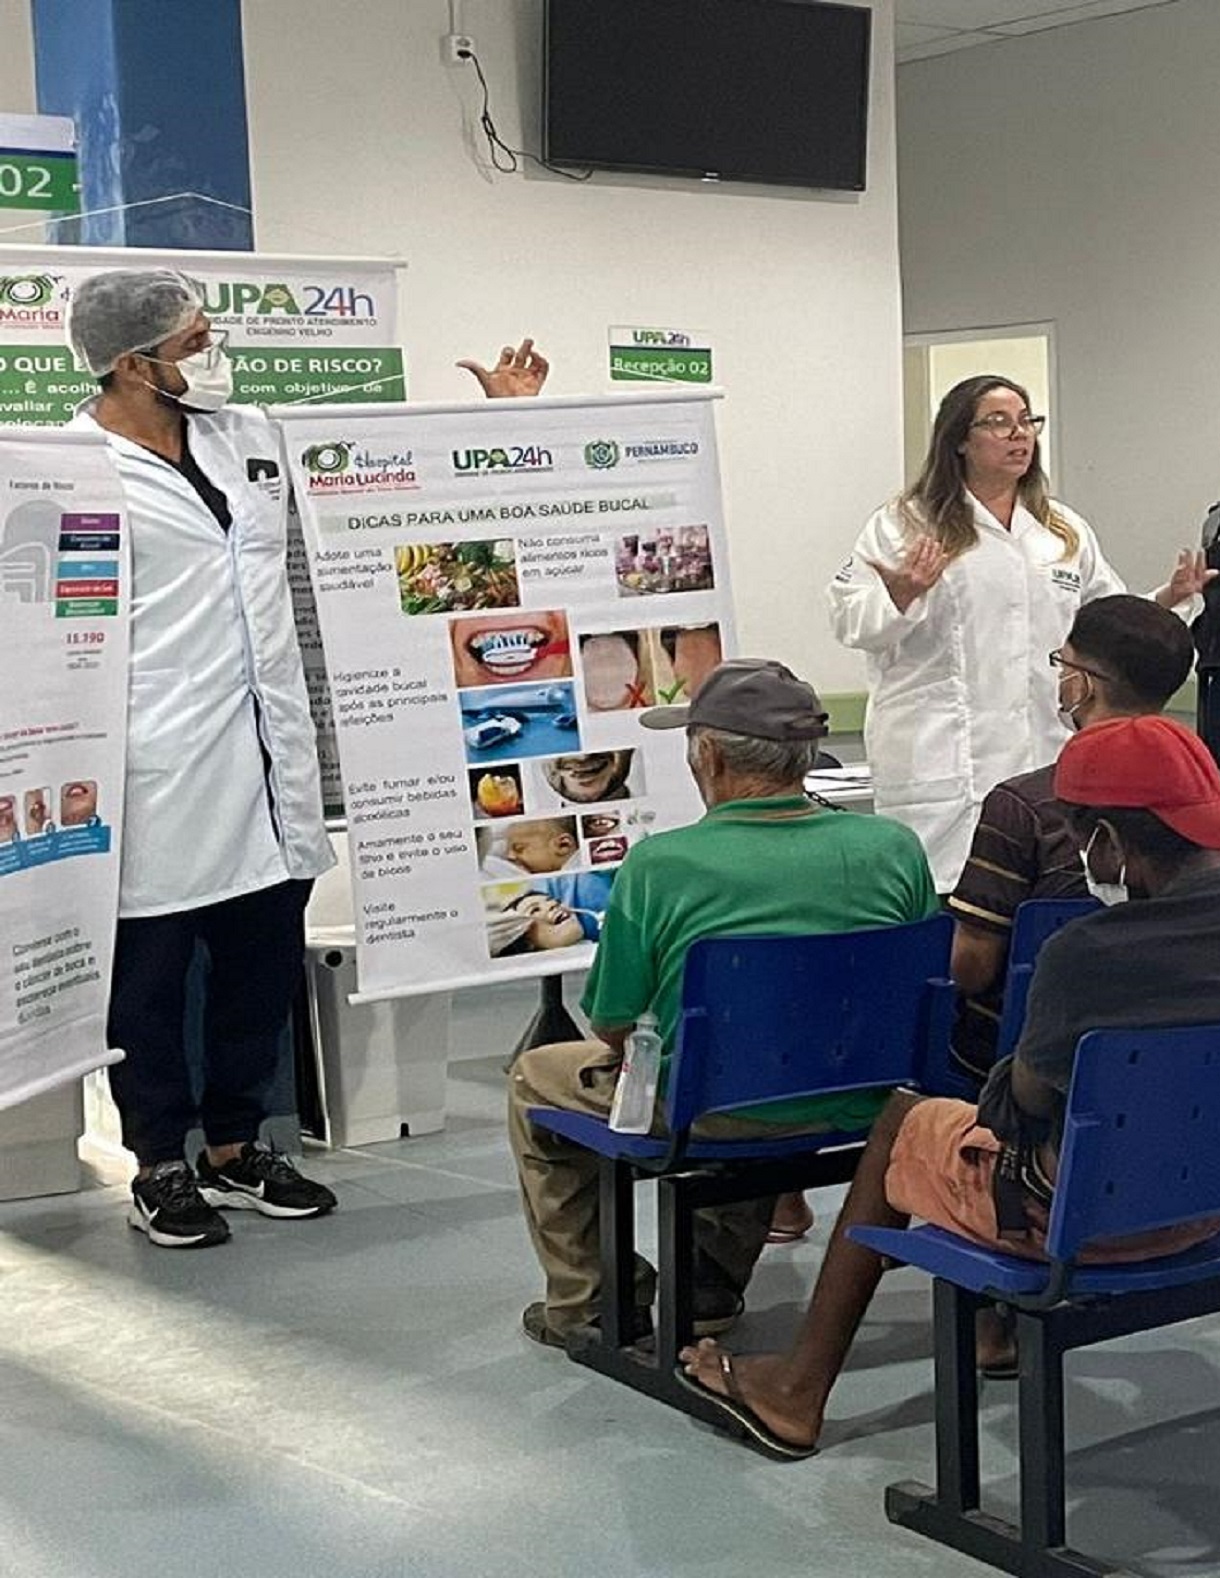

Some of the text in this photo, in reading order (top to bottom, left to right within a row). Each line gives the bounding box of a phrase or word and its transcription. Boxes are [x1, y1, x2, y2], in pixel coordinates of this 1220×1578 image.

[0, 164, 53, 198] 02
[0, 307, 59, 321] Maria
[246, 317, 261, 325] DE
[263, 317, 305, 325] PRONTO
[307, 317, 377, 326] ATENDIMENTO
[299, 328, 333, 337] VELHO
[14, 357, 67, 374] QUE
[274, 358, 302, 373] DE
[309, 358, 382, 373] RISCO?
[614, 358, 709, 376] Recepção 02
[47, 382, 103, 394] acolh
[240, 384, 276, 394] com
[284, 382, 350, 396] objetivo
[0, 400, 53, 412] valiar
[624, 442, 699, 458] PERNAMBUCO
[347, 513, 402, 530] DICAS
[406, 511, 455, 526] PARA
[458, 508, 496, 523] UMA
[500, 505, 536, 519] BOA
[598, 498, 653, 512] BUCAL
[392, 678, 427, 691] bucal
[348, 782, 377, 795] Evite
[383, 777, 420, 790] fumar
[407, 788, 458, 802] bebidas
[439, 830, 462, 840] seu
[431, 847, 441, 856] o
